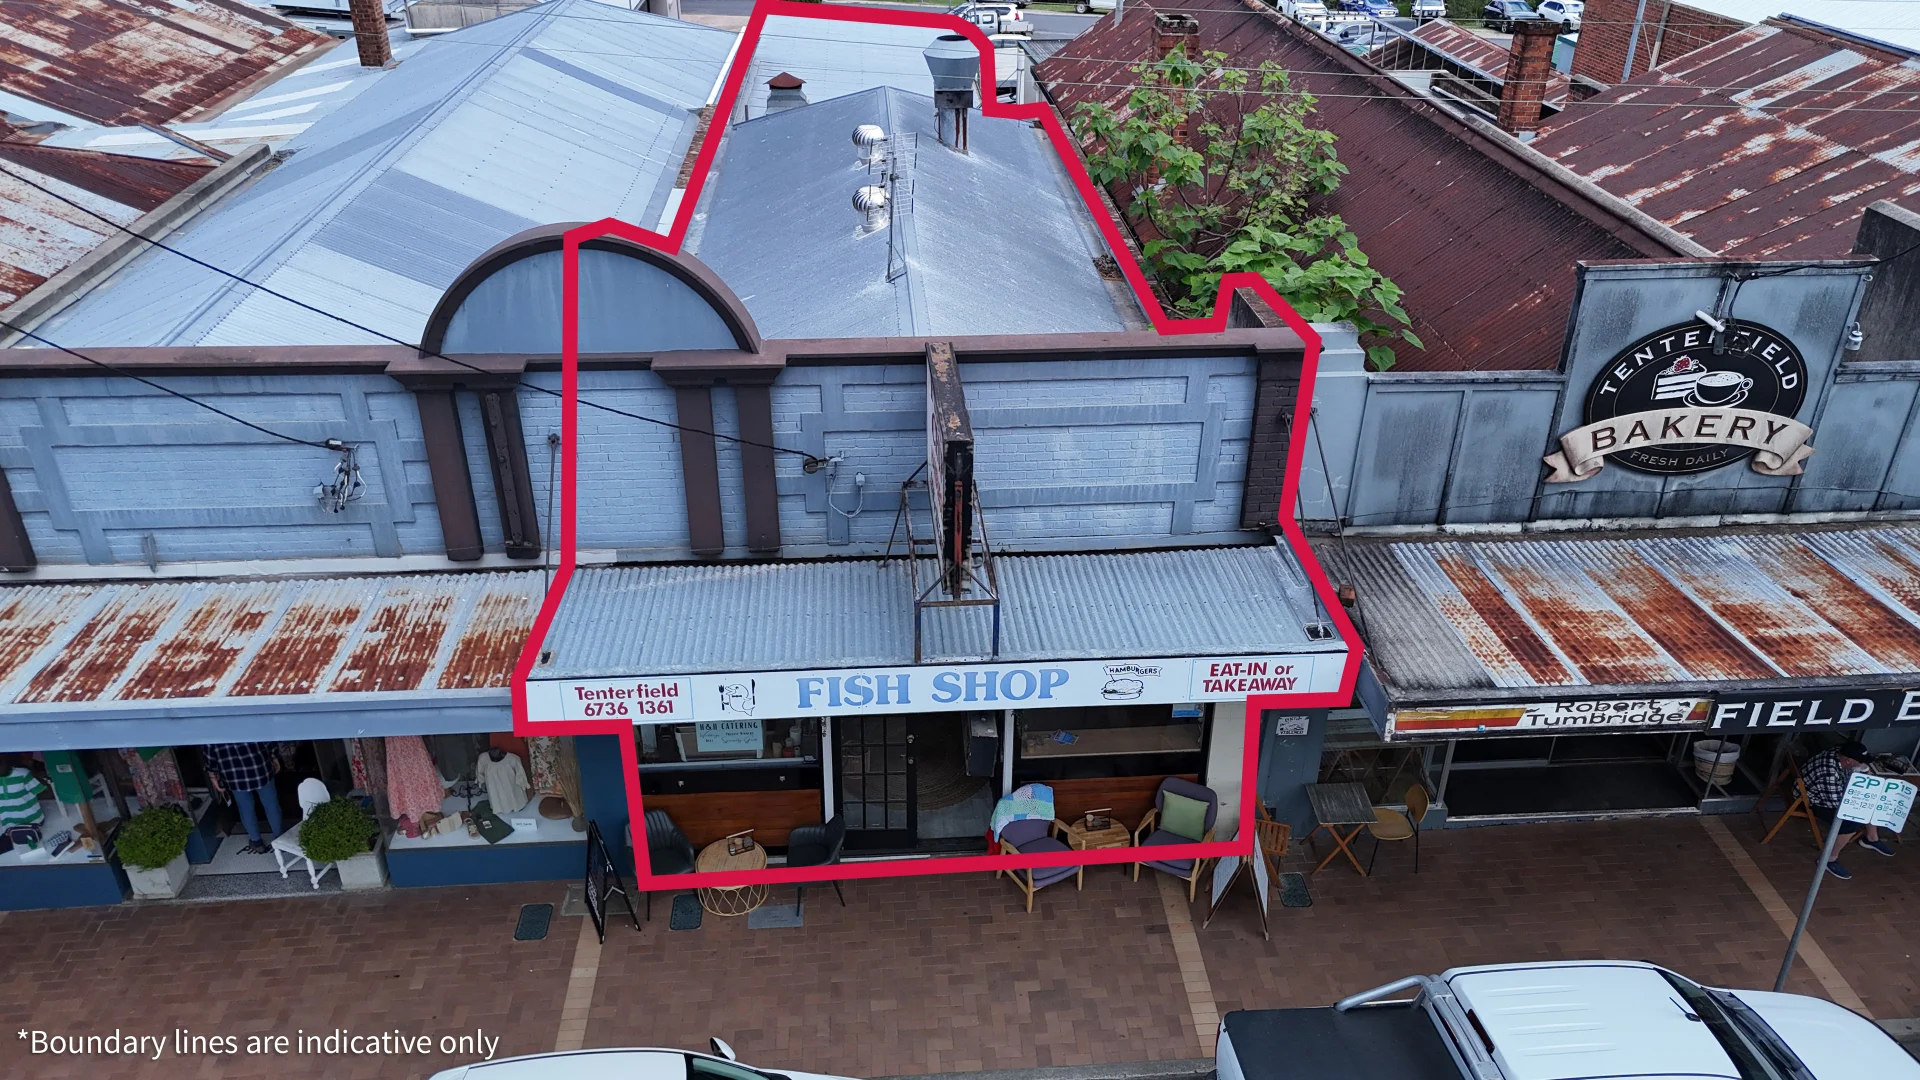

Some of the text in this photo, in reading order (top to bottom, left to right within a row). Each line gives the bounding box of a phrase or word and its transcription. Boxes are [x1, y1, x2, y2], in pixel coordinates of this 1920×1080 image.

[1591, 413, 1790, 453] BAKERY
[1630, 448, 1729, 467] FRESH DAILY
[1109, 666, 1158, 675] HAMBURGERS
[1209, 662, 1294, 677] EAT-IN or
[574, 682, 679, 700] Tenterfield
[797, 669, 1070, 708] FISH SHOP
[1203, 676, 1298, 693] TAKEAWAY
[584, 700, 674, 717] 6736 1361
[1555, 700, 1661, 713] Robert
[1710, 698, 1876, 729] FIELD
[721, 722, 758, 730] CATERING
[1527, 711, 1684, 726] Tumbridge
[1852, 776, 1881, 789] 2P
